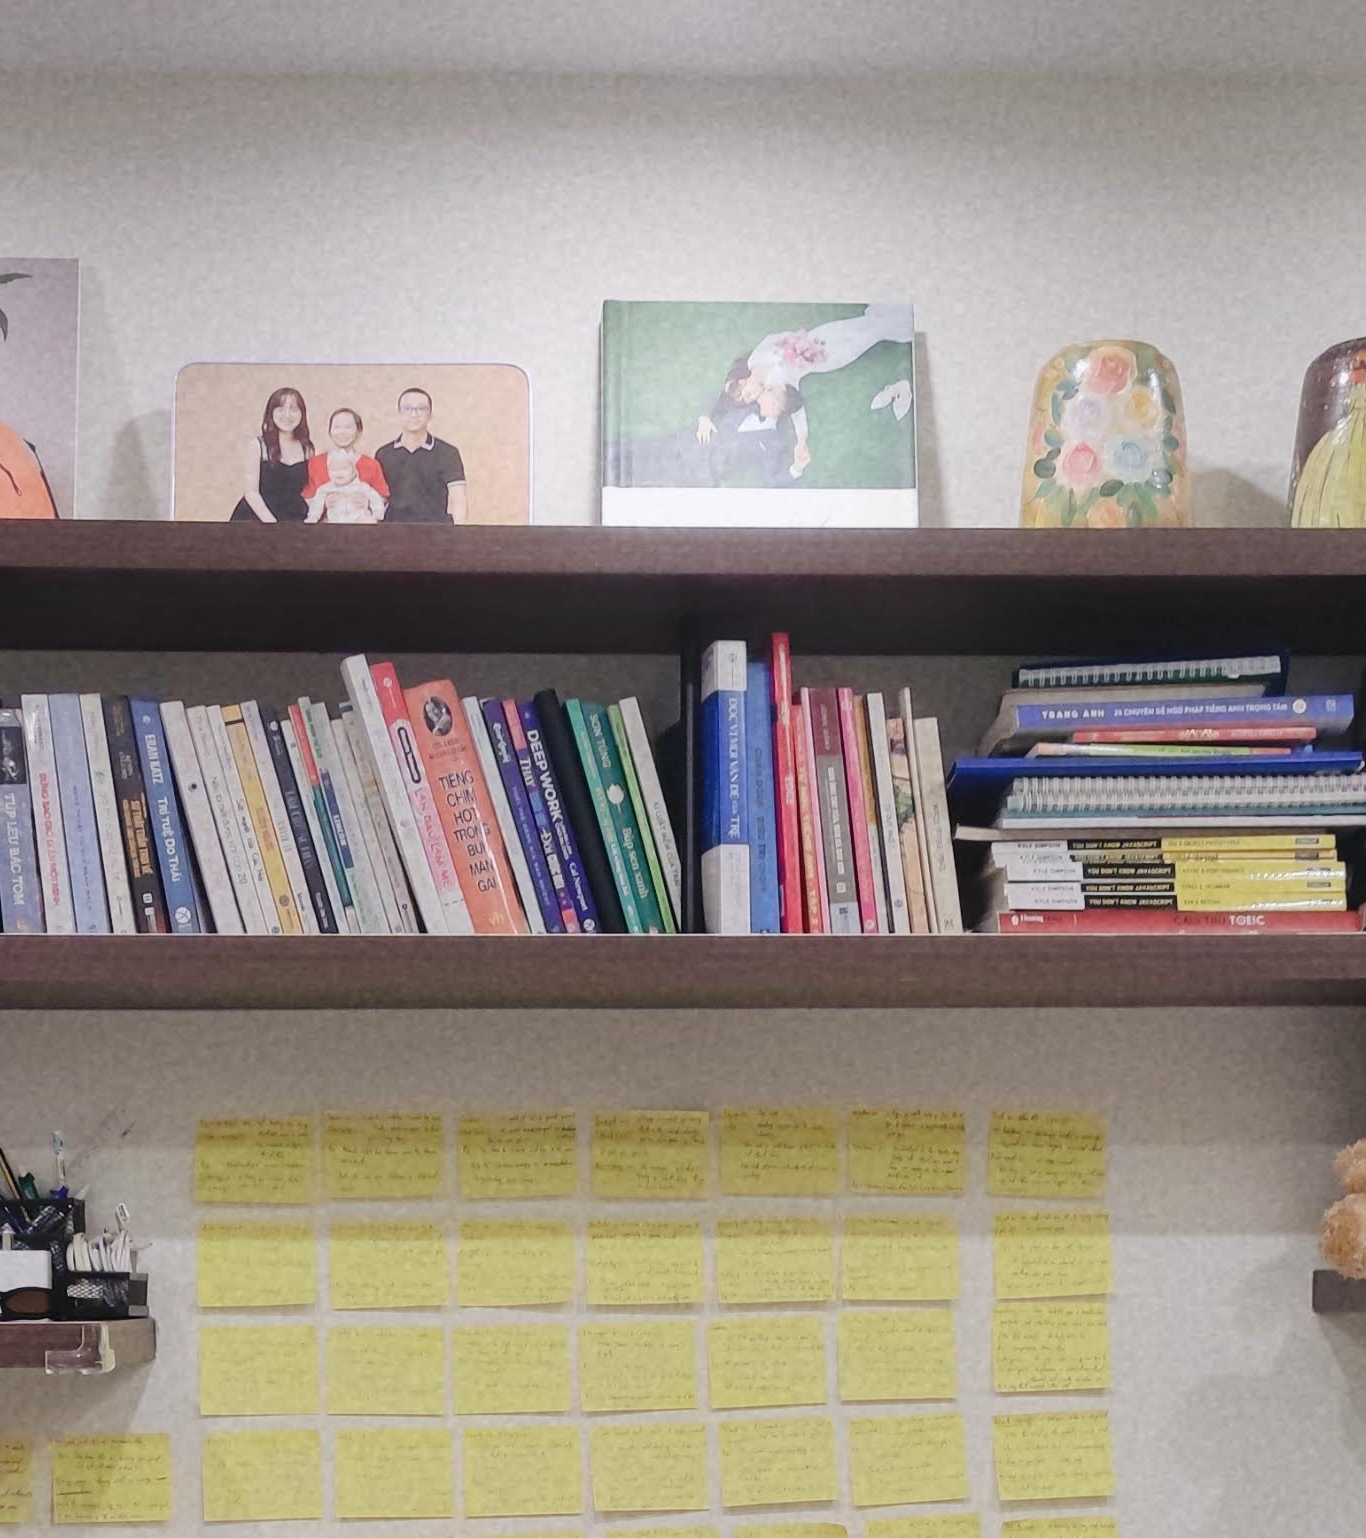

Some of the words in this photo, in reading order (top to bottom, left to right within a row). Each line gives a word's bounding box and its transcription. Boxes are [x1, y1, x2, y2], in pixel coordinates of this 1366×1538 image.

[1082, 708, 1105, 718] ANH
[525, 727, 549, 772] DEEP
[538, 769, 564, 822] WORK
[626, 850, 641, 871] sen
[631, 869, 650, 900] xanh
[1229, 915, 1266, 926] TOEIC
